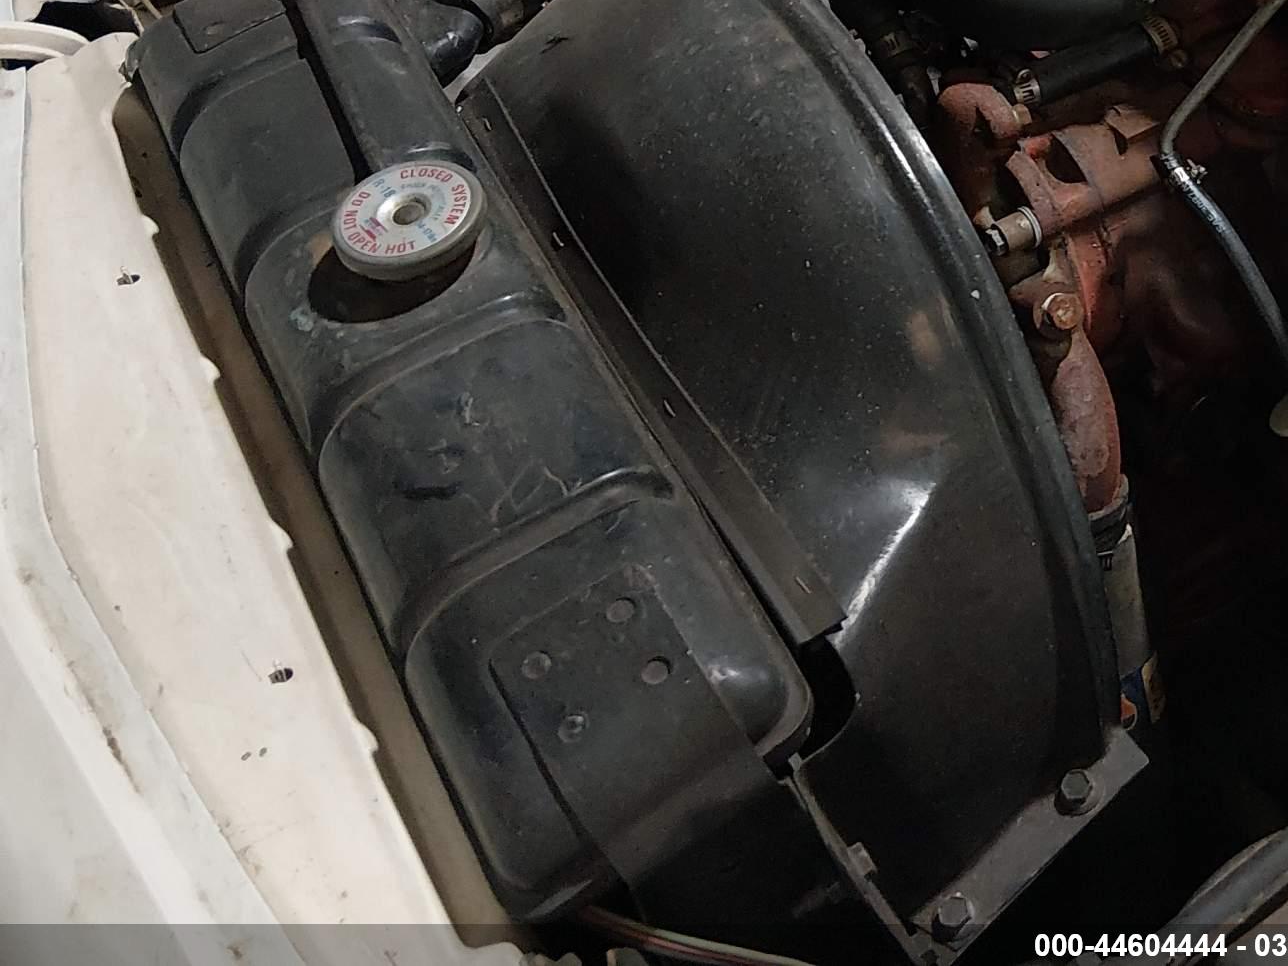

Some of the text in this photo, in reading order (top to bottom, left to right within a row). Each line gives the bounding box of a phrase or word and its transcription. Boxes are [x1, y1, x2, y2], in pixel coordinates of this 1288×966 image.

[352, 190, 371, 207] DO
[400, 168, 453, 183] CLOSED
[444, 184, 467, 226] SYSTEM
[343, 209, 358, 231] NOT
[348, 232, 381, 254] OPEN
[384, 240, 416, 255] HOT
